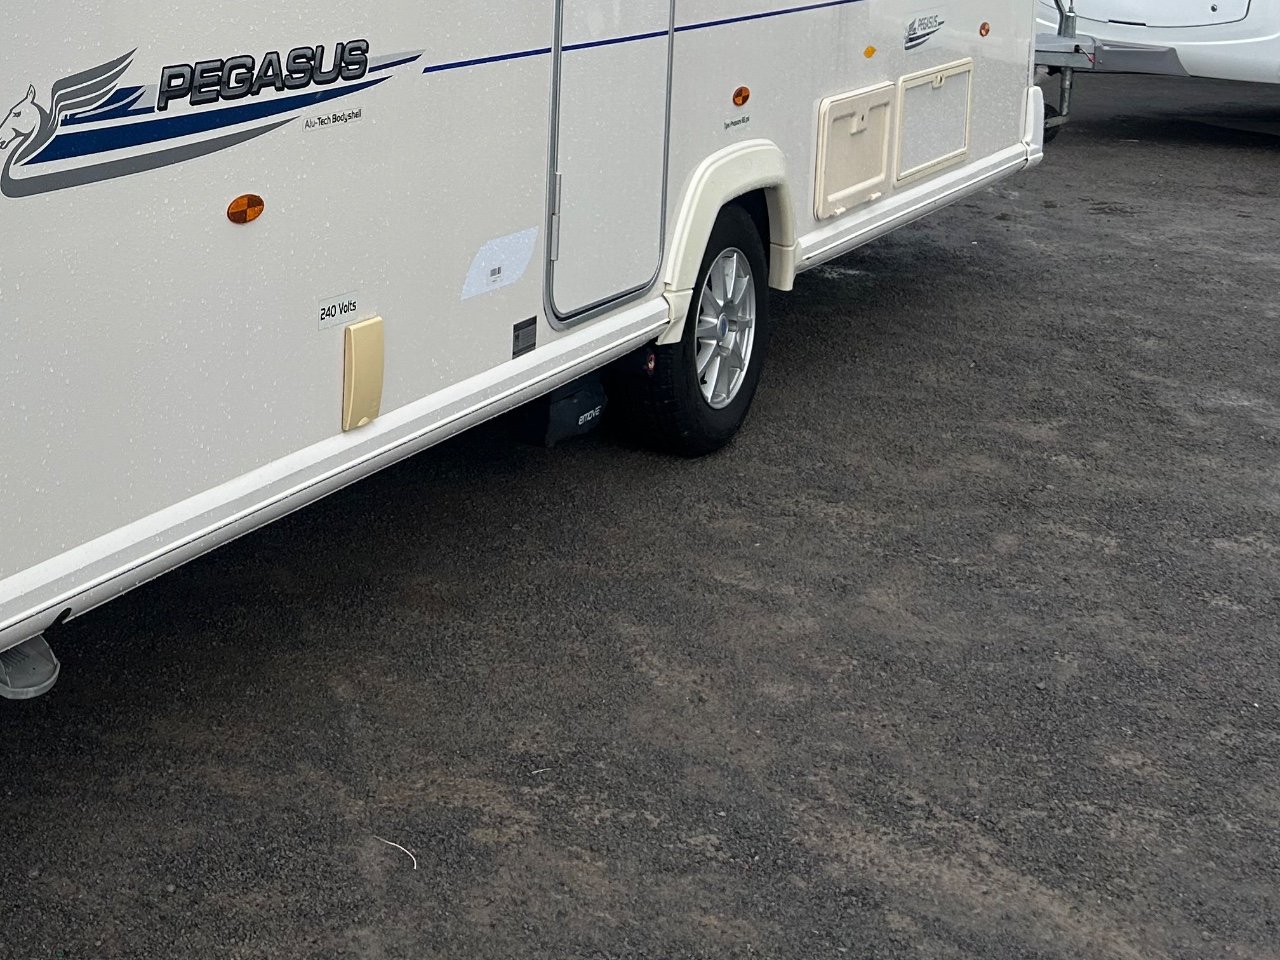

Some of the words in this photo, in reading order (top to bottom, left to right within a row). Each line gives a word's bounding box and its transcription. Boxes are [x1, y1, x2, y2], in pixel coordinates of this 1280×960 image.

[157, 38, 370, 112] PEGASUS
[304, 115, 331, 129] Alu-Tech
[332, 109, 361, 123] Bodyshell
[320, 305, 337, 321] 240
[338, 299, 357, 315] Volts
